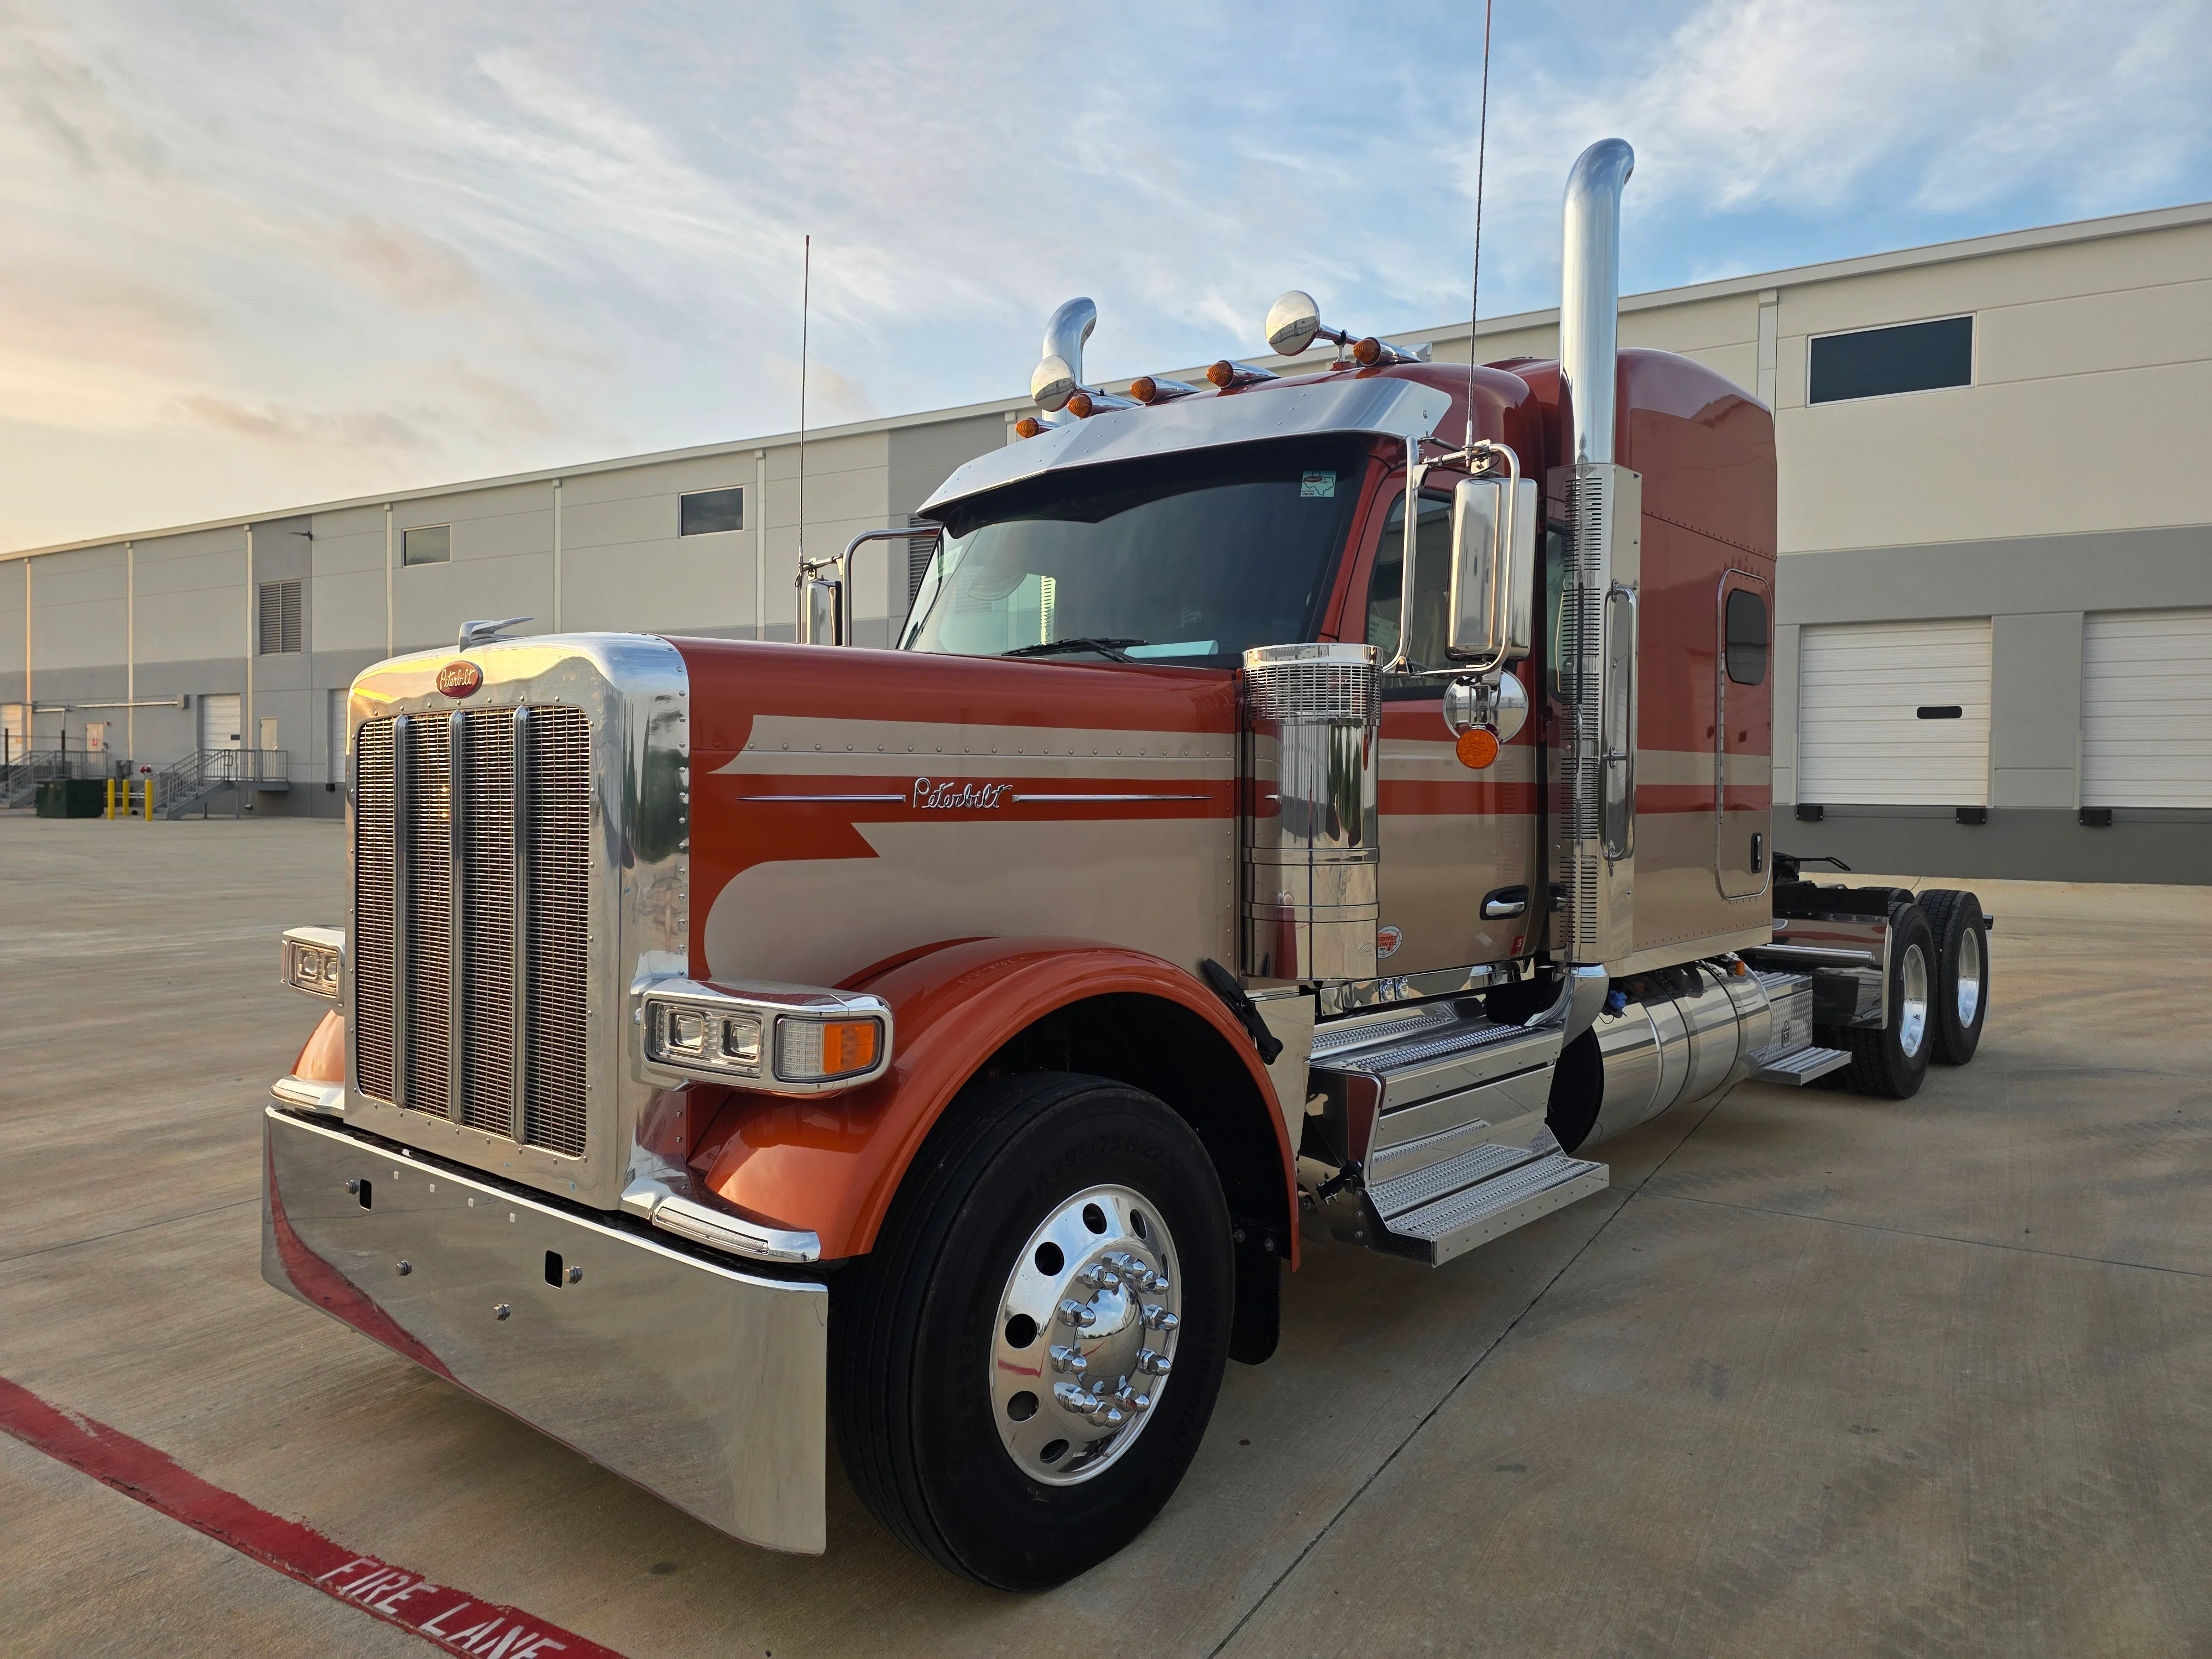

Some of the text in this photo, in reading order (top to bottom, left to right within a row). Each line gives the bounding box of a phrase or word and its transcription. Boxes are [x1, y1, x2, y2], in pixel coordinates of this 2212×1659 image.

[440, 668, 476, 690] Peterbilt
[912, 777, 1014, 809] Peterbilt
[316, 1557, 439, 1615] FIRE
